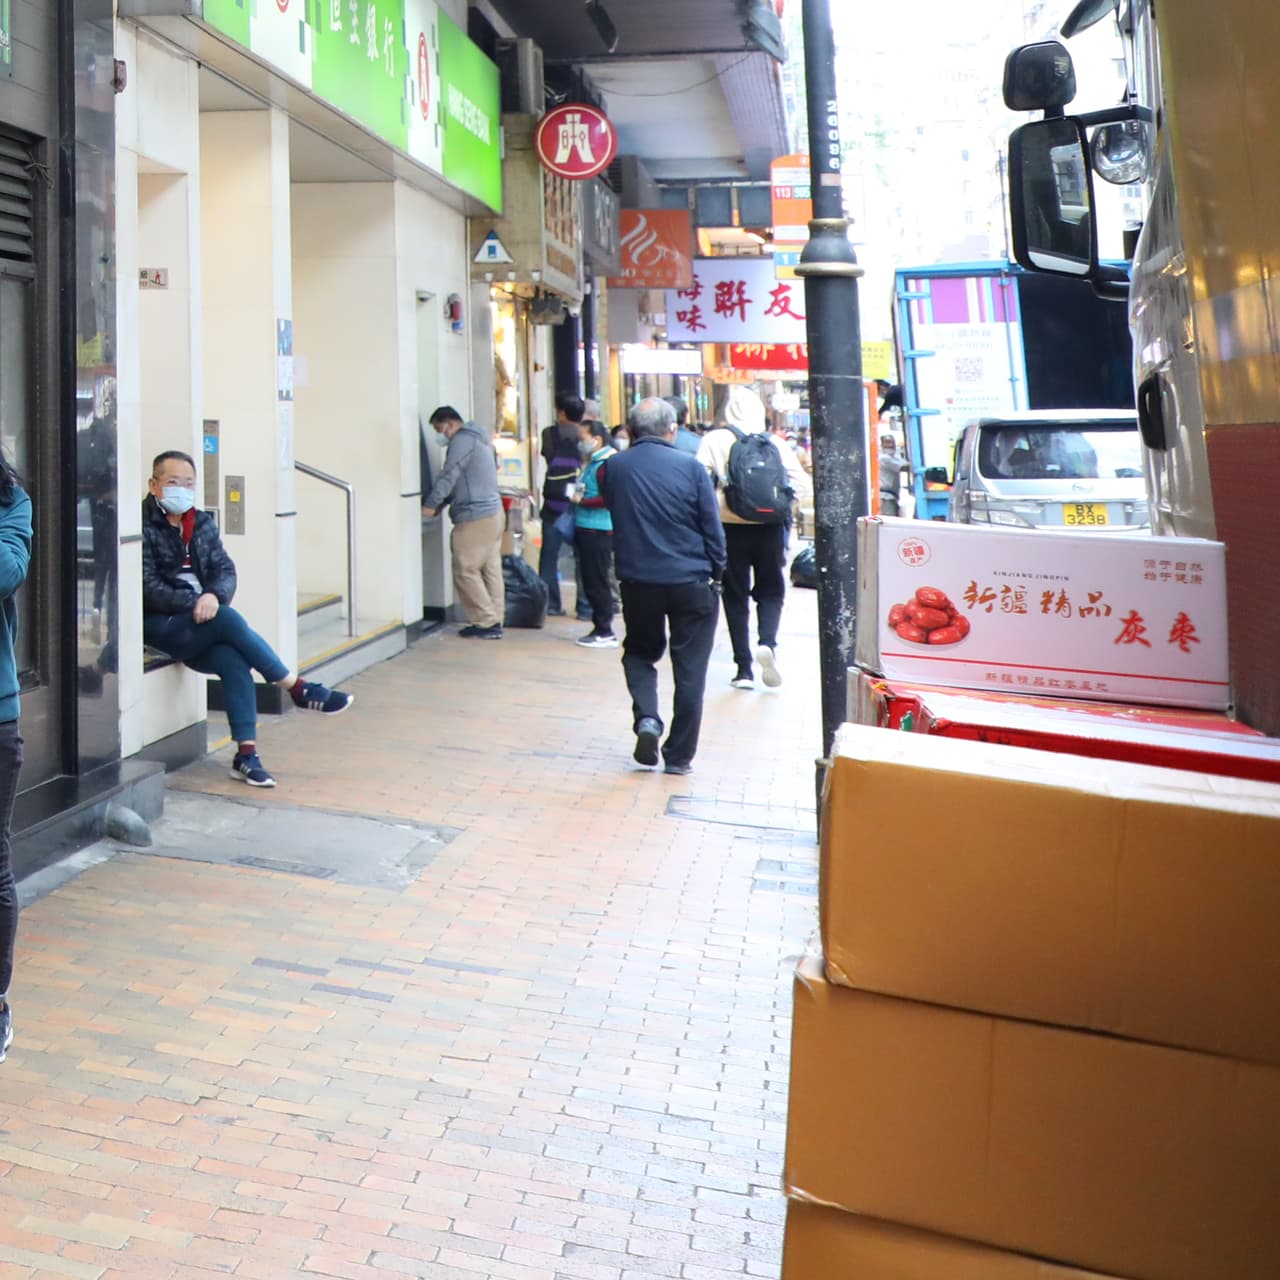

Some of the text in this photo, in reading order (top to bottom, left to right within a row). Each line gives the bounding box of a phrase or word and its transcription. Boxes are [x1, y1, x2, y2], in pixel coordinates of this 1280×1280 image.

[775, 187, 791, 199] 113
[1074, 504, 1096, 516] BX
[1067, 513, 1107, 526] 3238
[902, 545, 926, 559] 新疆
[962, 580, 1112, 619] 新疆精品
[1114, 609, 1201, 655] 灰枣
